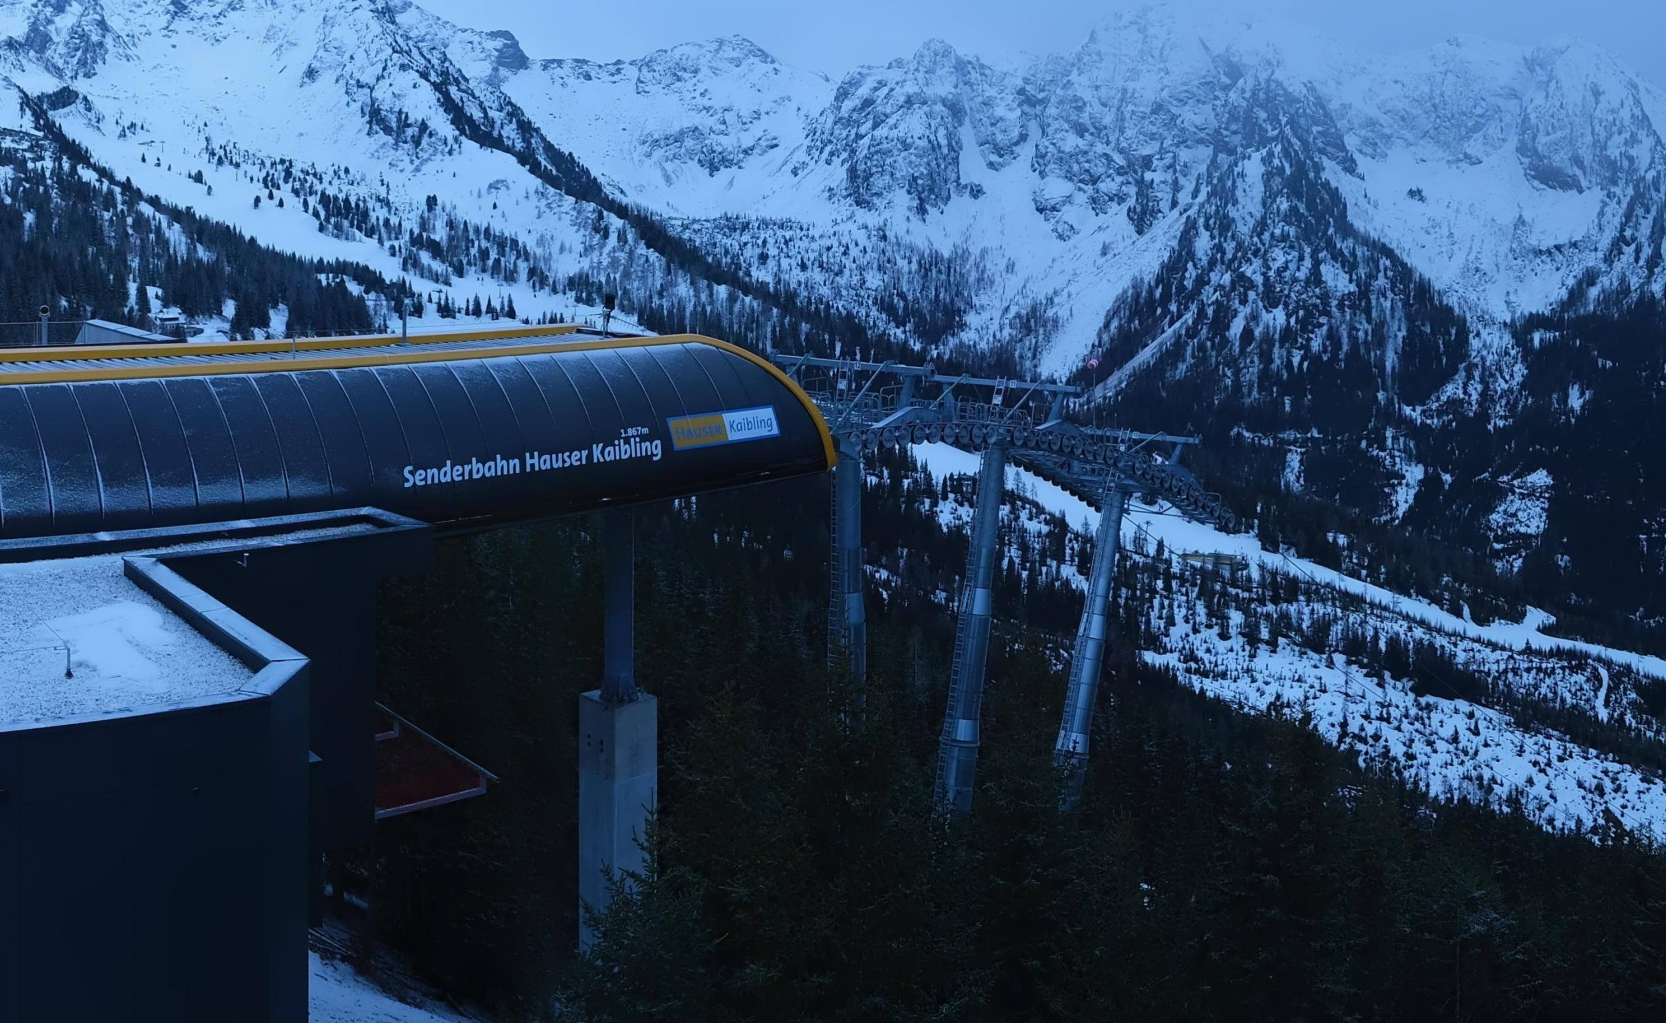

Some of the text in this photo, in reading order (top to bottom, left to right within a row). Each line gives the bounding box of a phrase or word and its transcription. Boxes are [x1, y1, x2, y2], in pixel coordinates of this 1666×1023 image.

[620, 426, 649, 438] 1.867m
[728, 416, 774, 434] Kaibling
[403, 438, 662, 488] Senderbahn Hauser Kaibling
